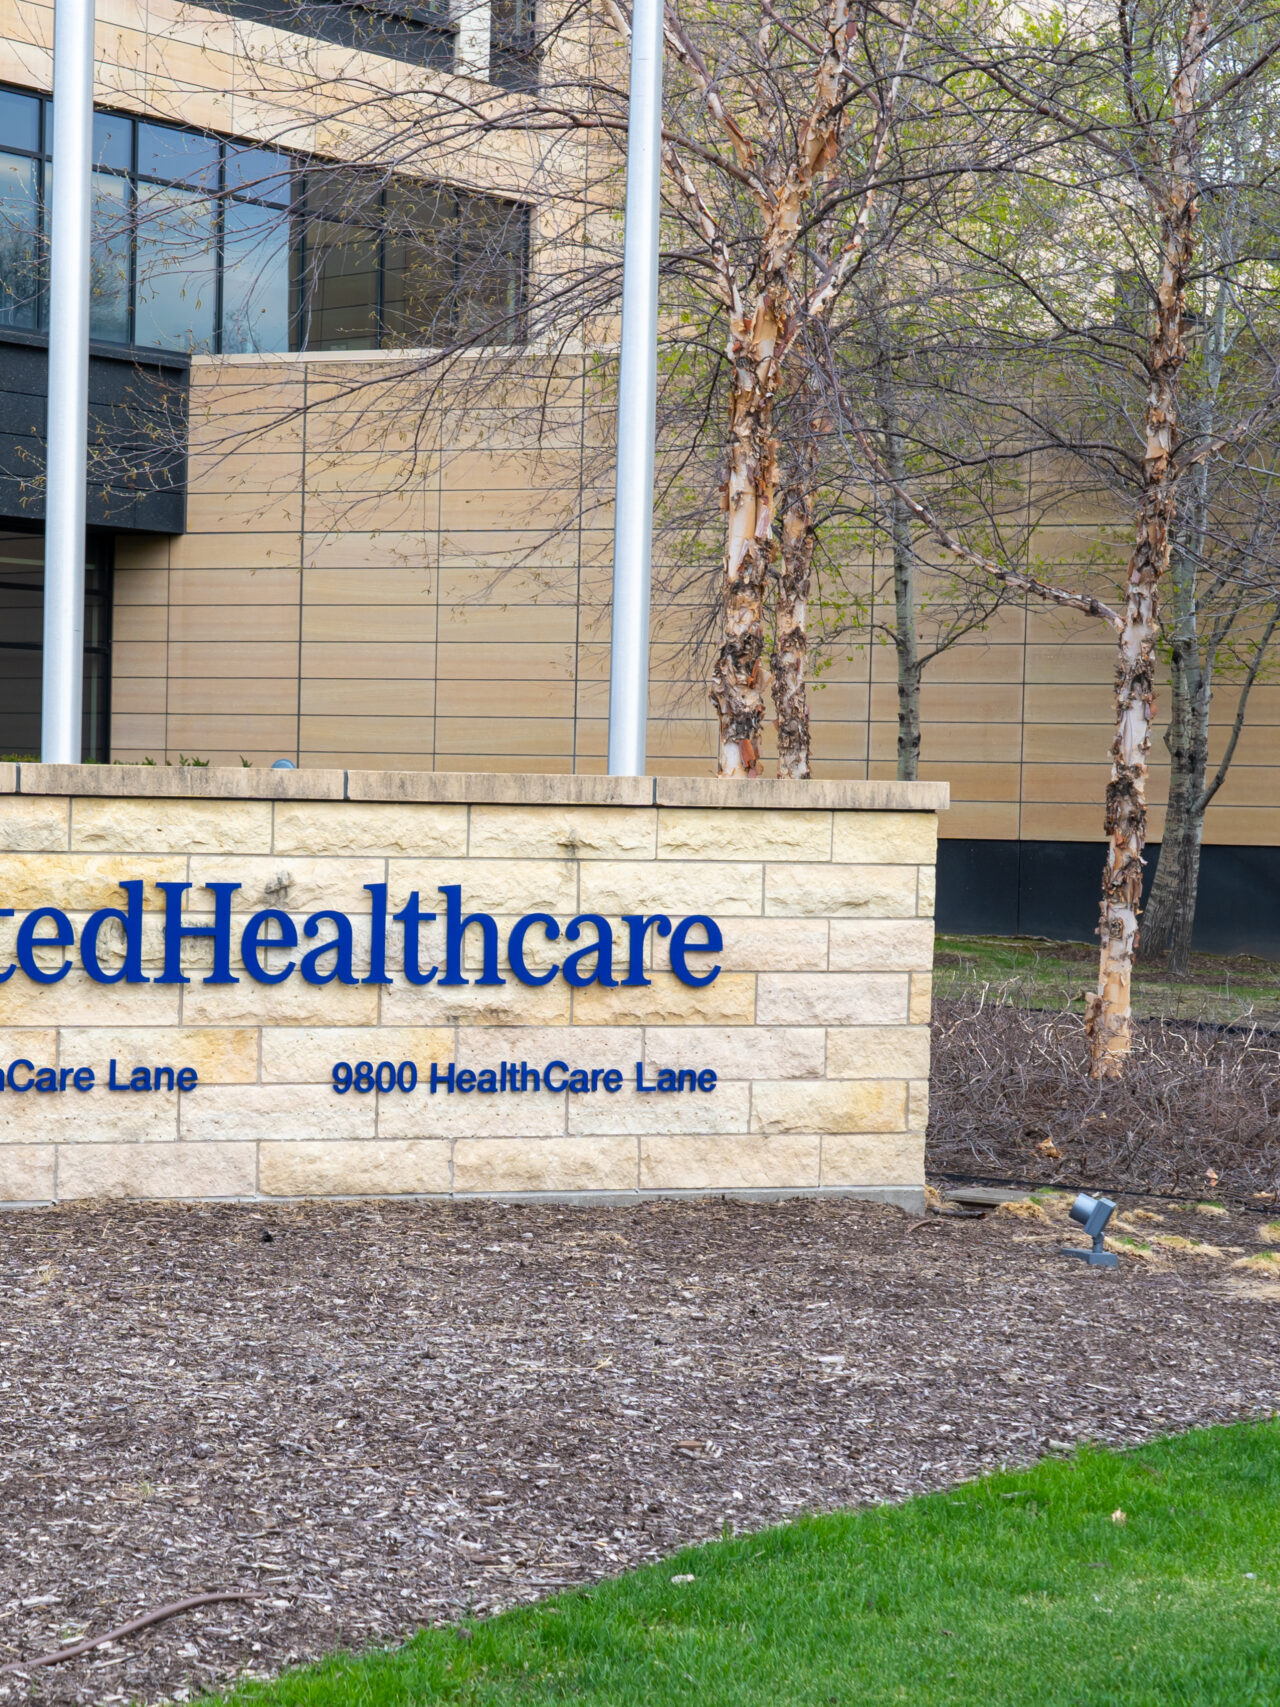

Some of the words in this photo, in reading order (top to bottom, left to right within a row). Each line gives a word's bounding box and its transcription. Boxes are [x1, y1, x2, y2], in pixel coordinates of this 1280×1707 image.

[108, 1058, 198, 1092] Lane
[331, 1060, 418, 1094] 9800
[429, 1060, 624, 1094] HealthCare
[635, 1061, 718, 1093] Lane
